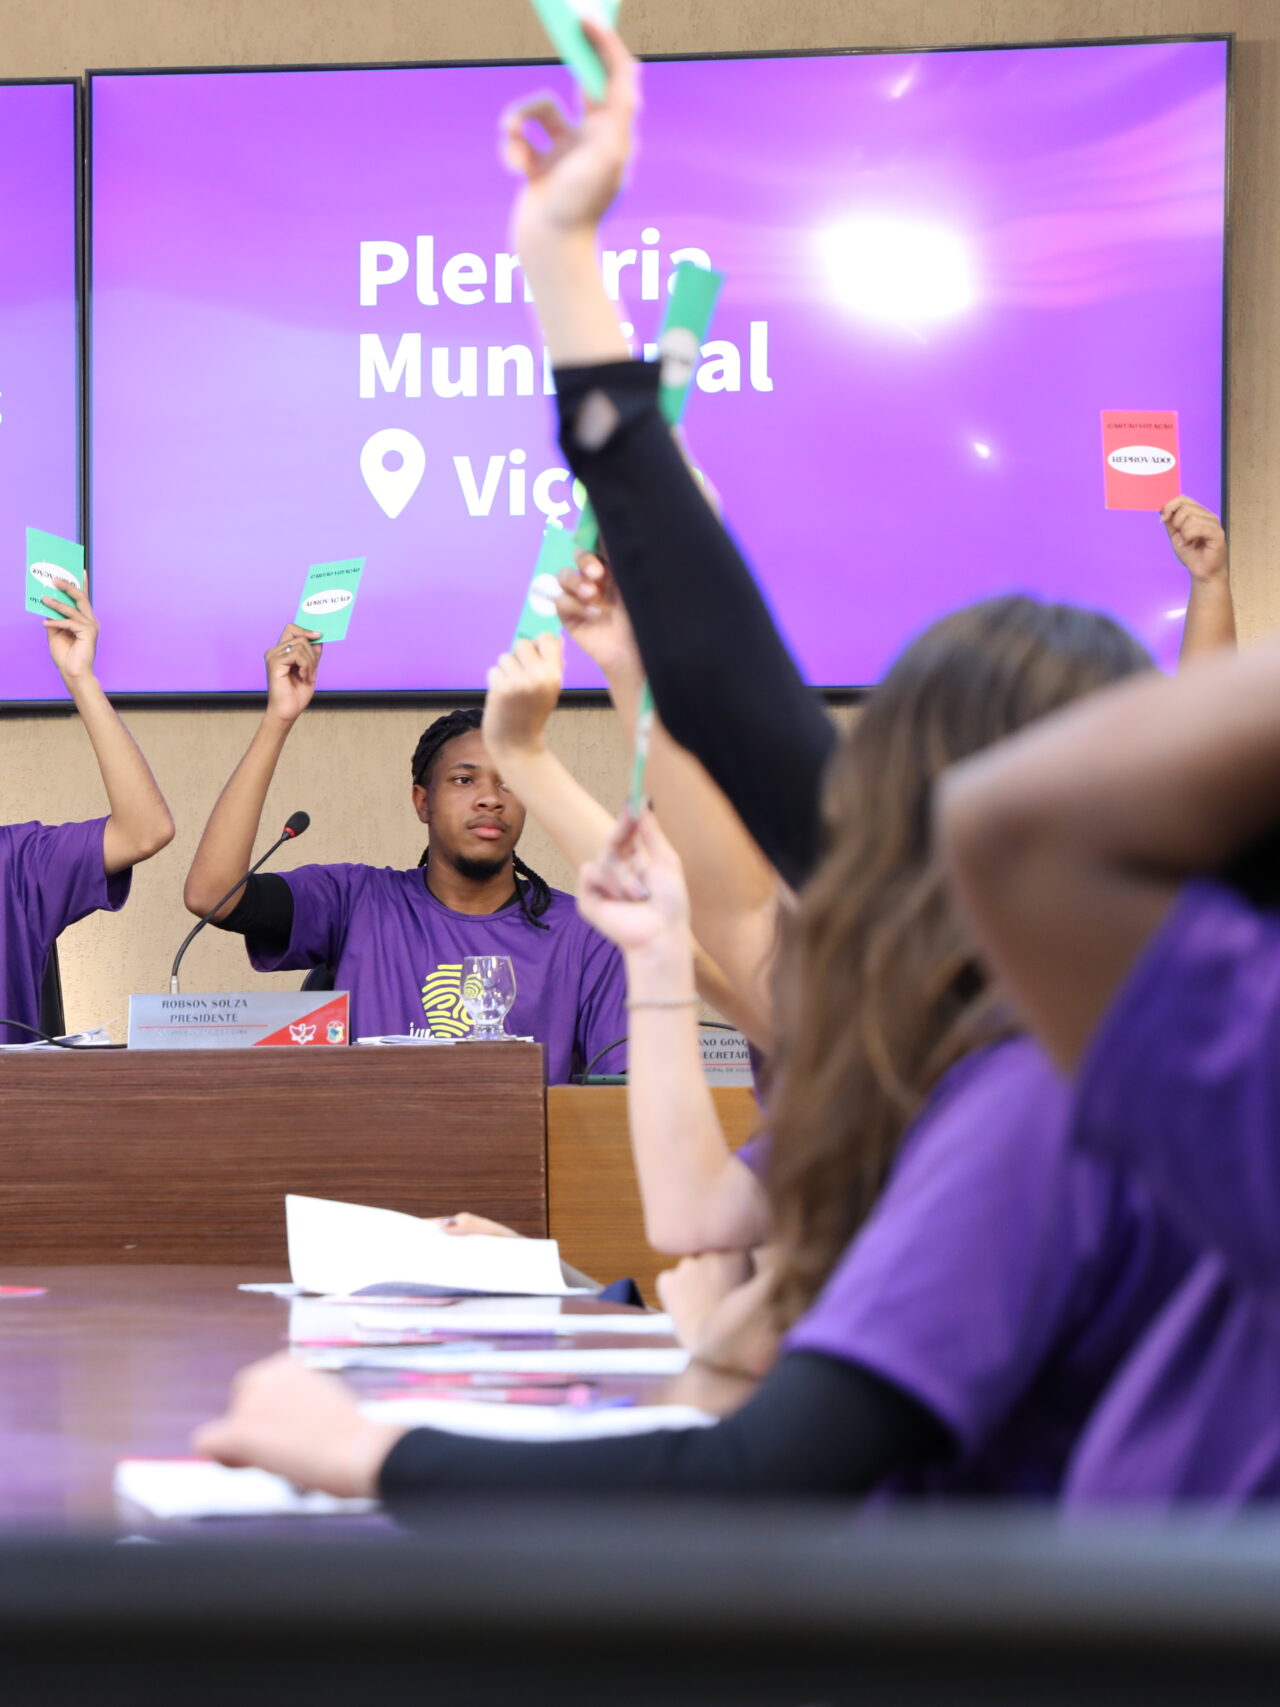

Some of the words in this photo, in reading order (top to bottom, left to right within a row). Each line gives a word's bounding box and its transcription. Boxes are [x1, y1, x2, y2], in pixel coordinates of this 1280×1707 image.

[161, 999, 207, 1009] ROBSON
[211, 999, 248, 1009] SOUZA
[170, 1013, 239, 1023] PRESIDENTE
